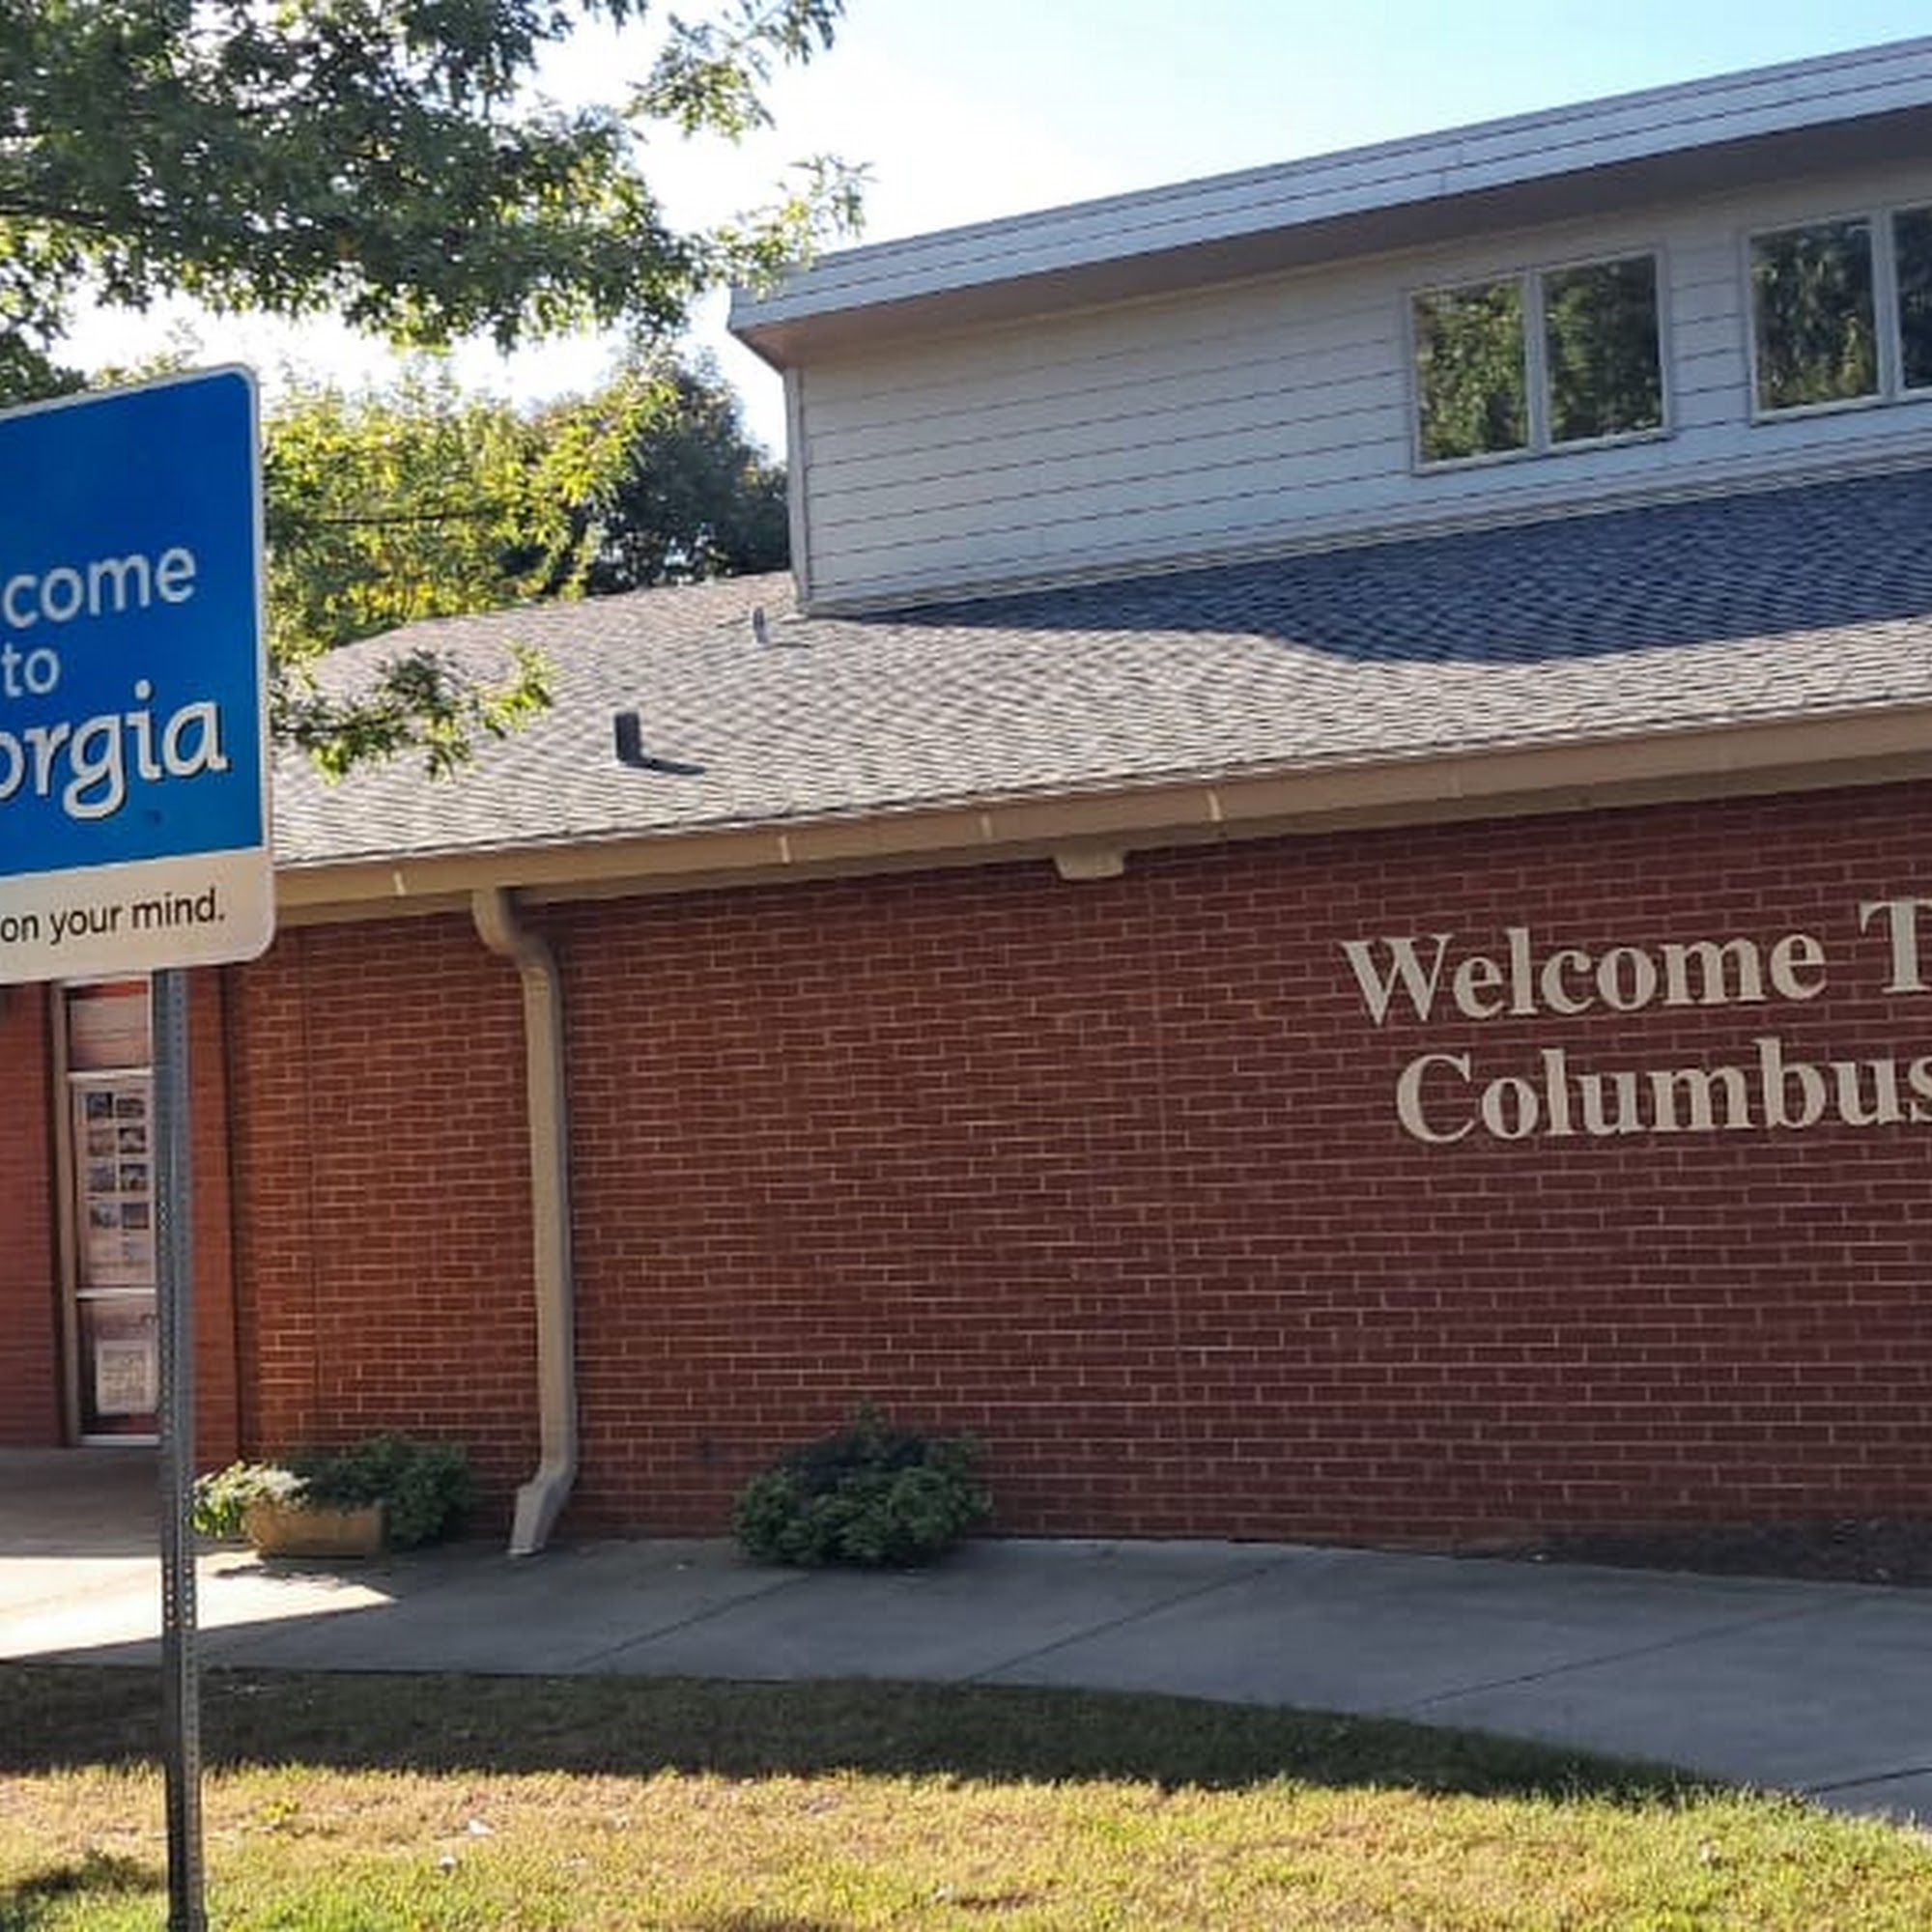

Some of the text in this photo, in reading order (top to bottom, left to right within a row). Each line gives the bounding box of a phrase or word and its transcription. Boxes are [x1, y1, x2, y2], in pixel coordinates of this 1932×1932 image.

[1, 641, 60, 696] to
[1, 886, 225, 946] on your mind.
[1341, 926, 1827, 1027] Welcome
